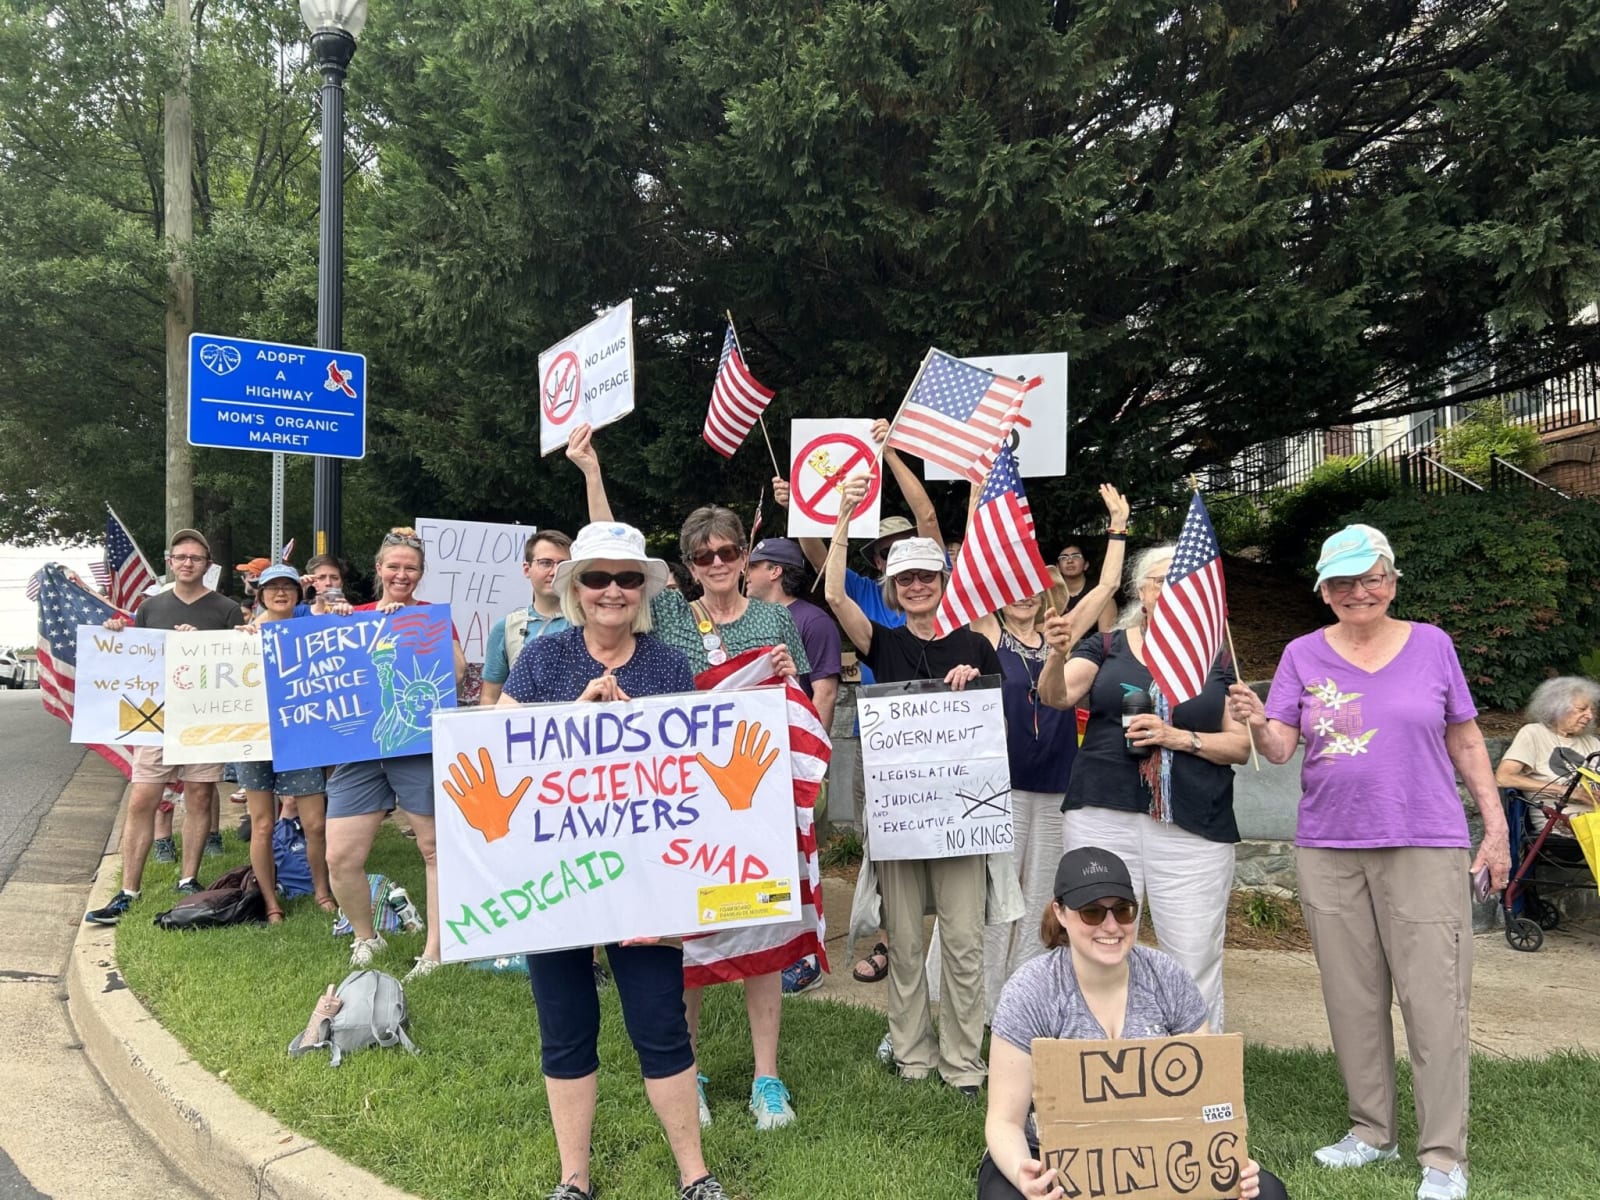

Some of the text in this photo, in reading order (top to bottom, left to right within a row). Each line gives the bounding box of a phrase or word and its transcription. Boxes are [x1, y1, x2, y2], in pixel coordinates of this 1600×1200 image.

[256, 350, 306, 365] ADOPT
[584, 336, 626, 369] NO LAWS
[275, 370, 286, 381] A
[584, 369, 630, 404] NO PEACE
[246, 385, 313, 402] HIGHWAY
[217, 411, 339, 432] MOM'S ORGANIC
[250, 431, 309, 446] MARKET
[439, 571, 505, 604] THE
[93, 634, 123, 655] We
[128, 643, 156, 663] only
[181, 642, 231, 657] WITH
[273, 617, 386, 679] LIBERTY
[308, 656, 346, 678] AND
[94, 675, 160, 697] we stop
[285, 668, 369, 700] JUSTICE
[193, 700, 254, 714] WHERE
[278, 694, 373, 728] FOR ALL
[862, 700, 998, 729] 3 BRANCHES OF
[505, 702, 735, 764] HANDS OFF
[869, 725, 984, 751] GOVERNMENT
[537, 754, 699, 805] SCIENCE
[879, 765, 969, 782] LEGISLATIVE
[881, 791, 943, 808] JUDICIAL
[534, 794, 700, 843] LAWYERS
[883, 816, 955, 833] EXECUTIVE
[946, 823, 1014, 850] NO KINGS
[661, 838, 769, 884] SNAP
[445, 850, 625, 945] MEDICAID
[1080, 1041, 1203, 1103] NO
[1205, 1110, 1232, 1120] TACO
[1045, 1131, 1239, 1198] KINGS
